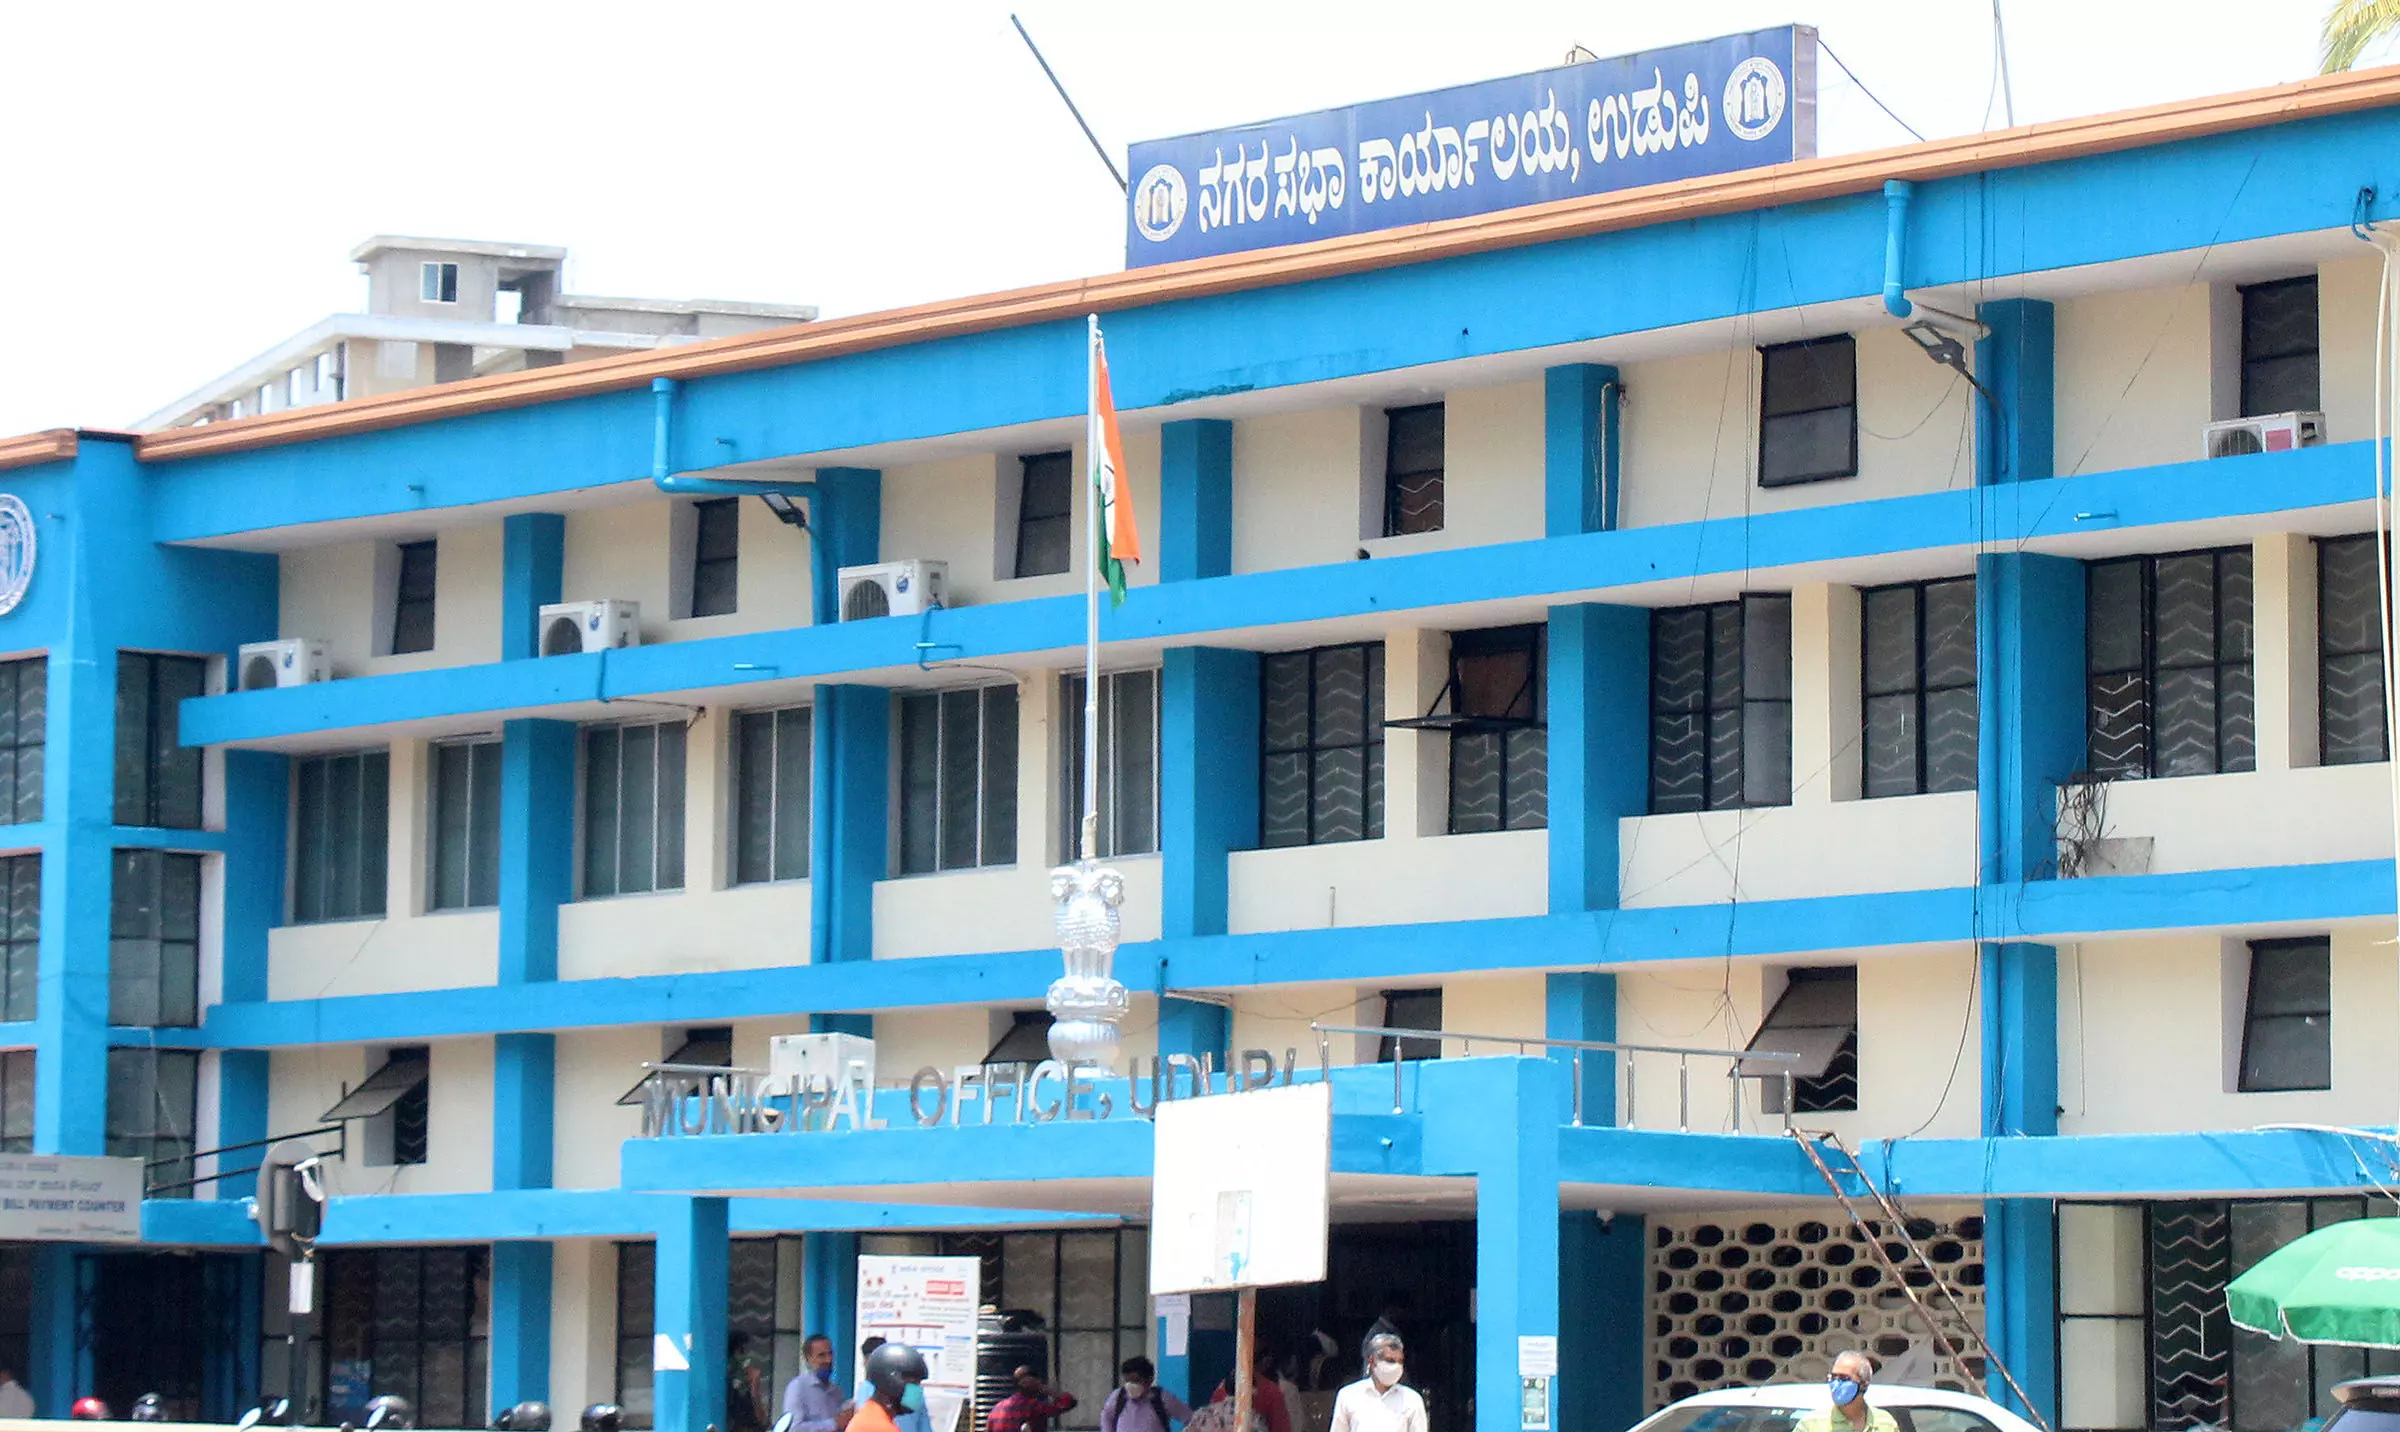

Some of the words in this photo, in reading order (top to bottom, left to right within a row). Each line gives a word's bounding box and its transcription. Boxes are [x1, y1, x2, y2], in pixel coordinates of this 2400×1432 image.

[1587, 66, 1710, 164] ಉಡುಪಿ
[641, 1060, 888, 1138] MUNICIPAL
[910, 1059, 1113, 1128] OFFICE,
[28, 1198, 74, 1212] PAYMENT
[77, 1199, 125, 1213] COUNTER
[2335, 1266, 2400, 1283] oppo
